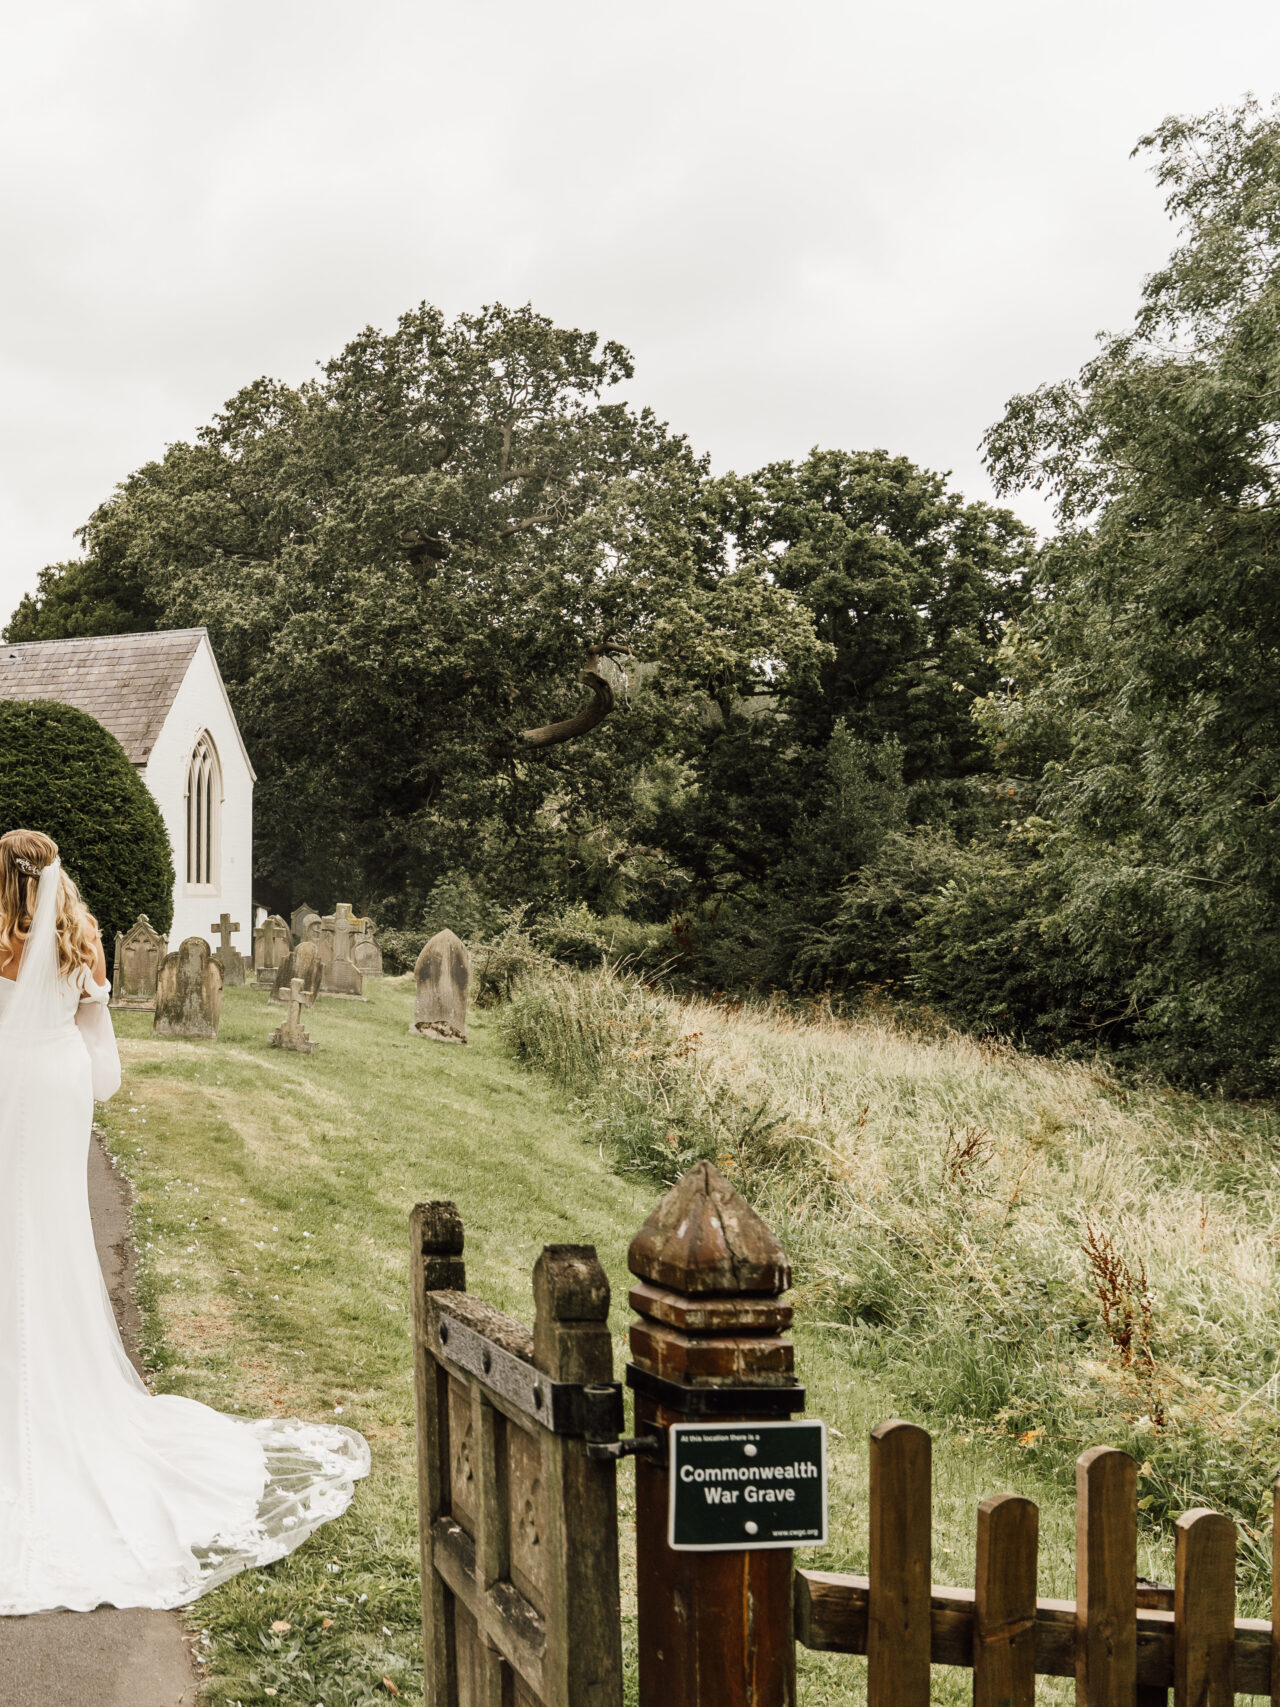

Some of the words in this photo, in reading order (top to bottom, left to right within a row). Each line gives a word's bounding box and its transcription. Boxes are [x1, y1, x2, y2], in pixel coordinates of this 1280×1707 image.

[689, 1434, 702, 1442] this
[703, 1434, 729, 1442] location
[730, 1433, 747, 1441] there
[680, 1461, 818, 1482] Commonwealth
[704, 1487, 739, 1504] War
[744, 1485, 796, 1503] Grave
[772, 1529, 819, 1537] www.cwgc.org
